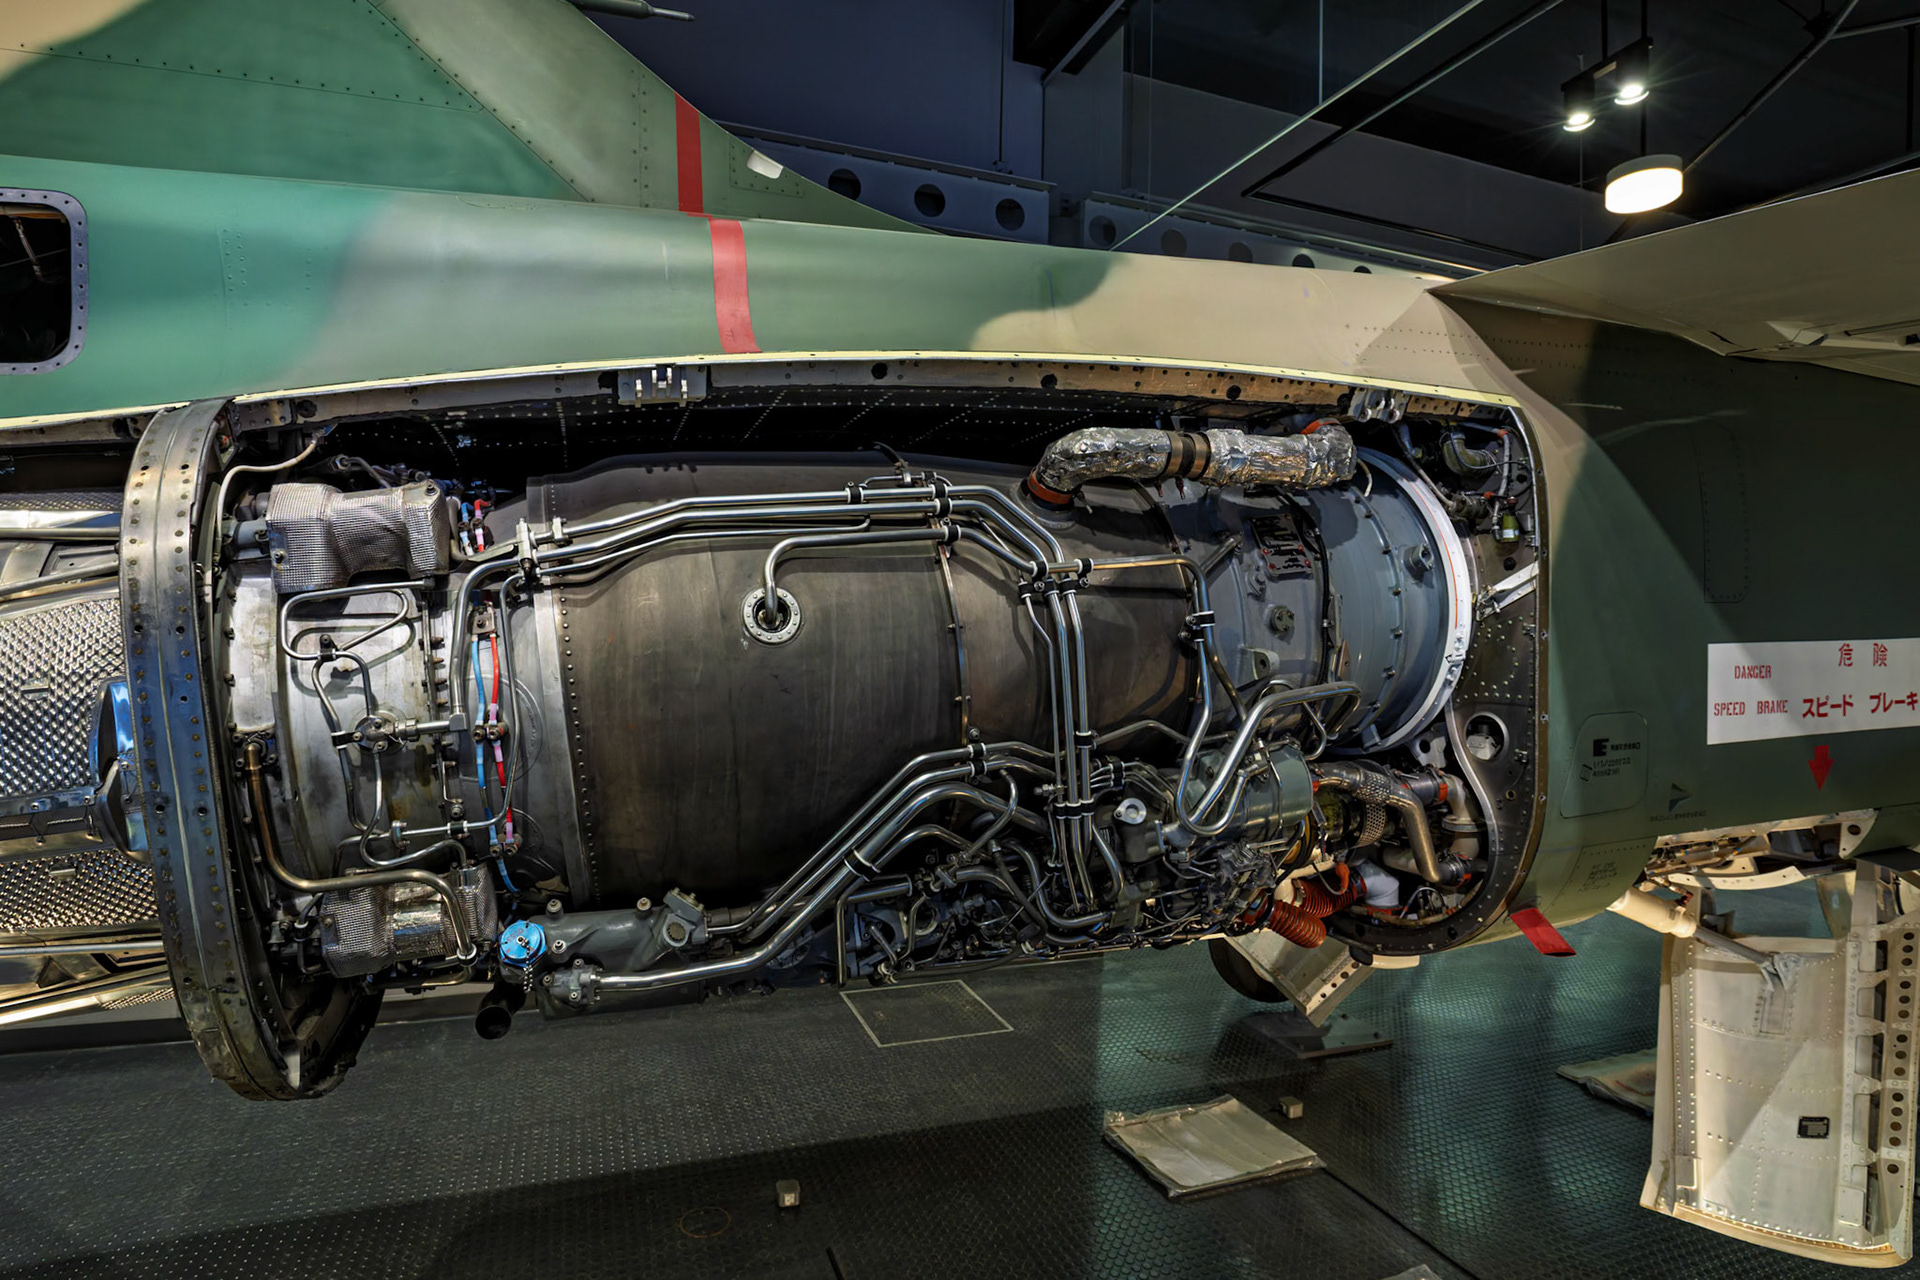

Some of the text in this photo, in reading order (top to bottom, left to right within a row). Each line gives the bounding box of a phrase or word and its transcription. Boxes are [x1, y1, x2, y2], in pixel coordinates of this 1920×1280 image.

[1734, 665, 1772, 679] DANGER
[1714, 699, 1788, 716] SPEED BRAKE
[1802, 691, 1918, 718] スピード ブレーキ
